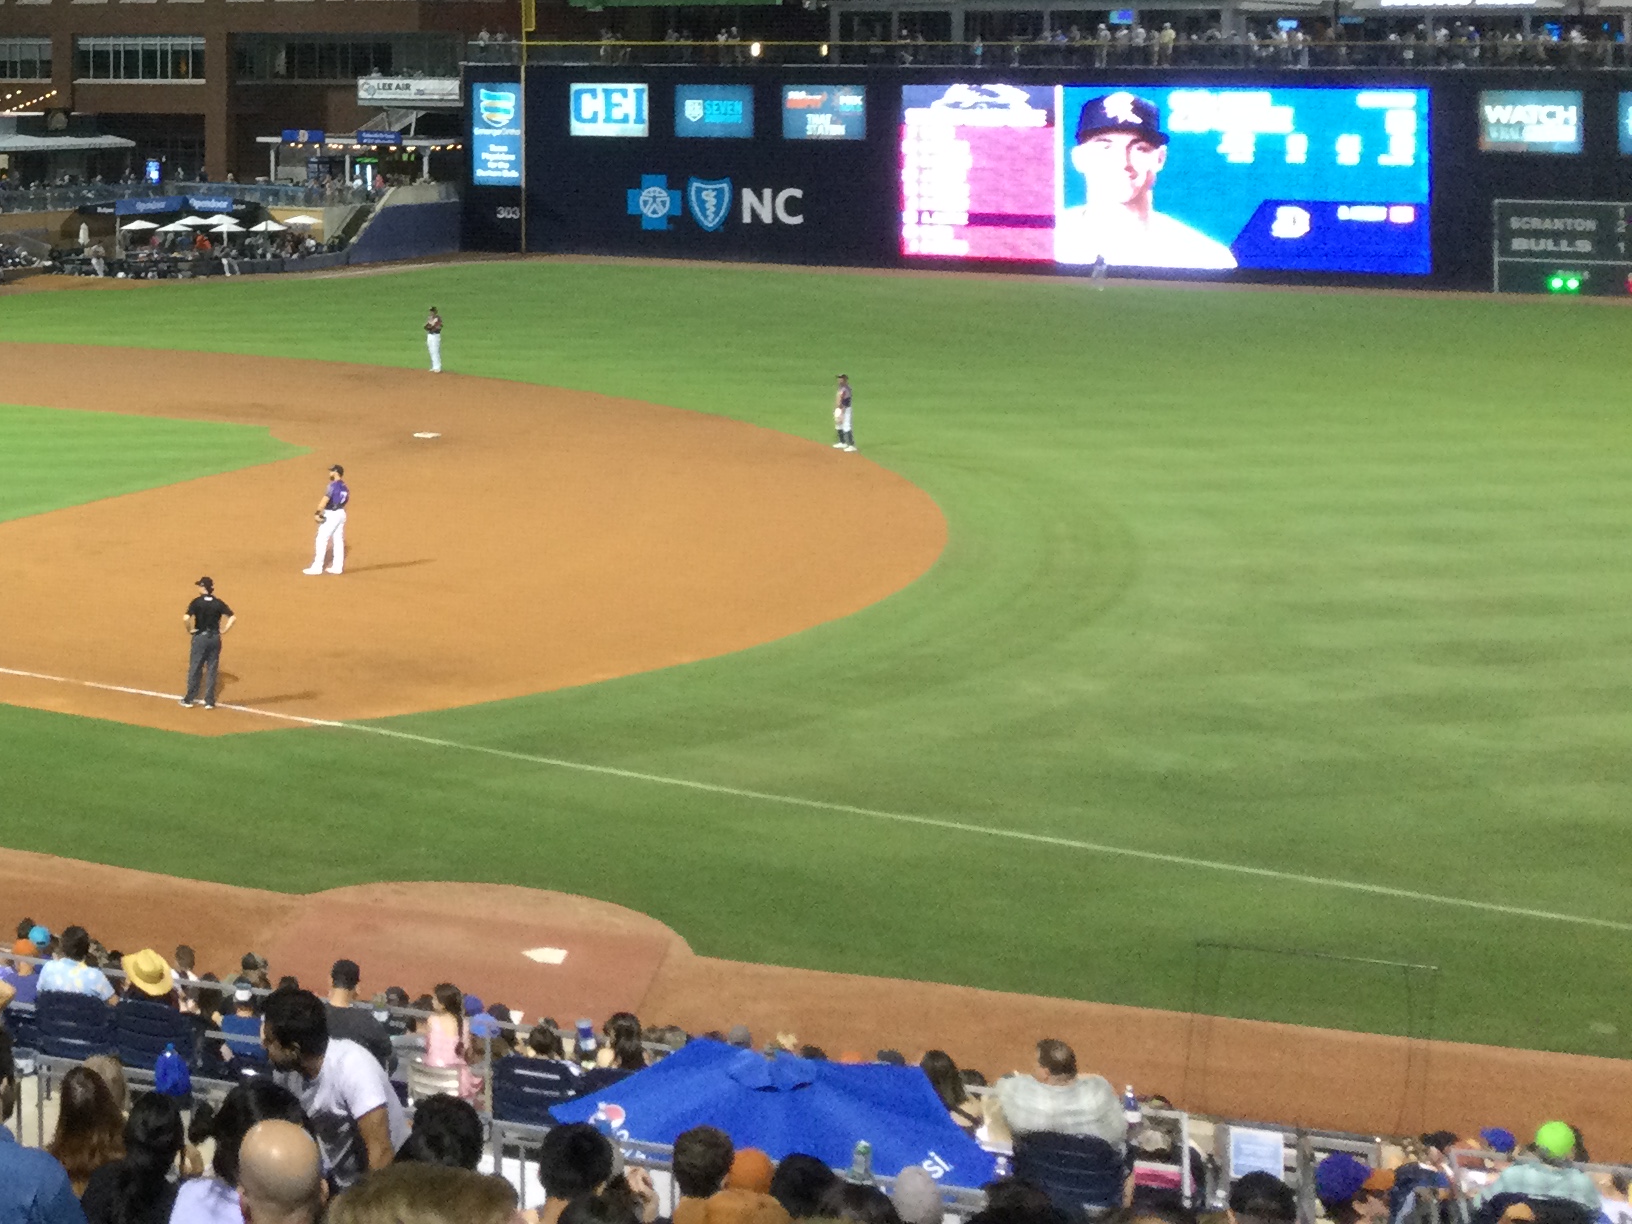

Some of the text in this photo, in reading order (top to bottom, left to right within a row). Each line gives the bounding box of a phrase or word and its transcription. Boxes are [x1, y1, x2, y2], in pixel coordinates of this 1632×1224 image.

[573, 88, 646, 124] CEI
[1484, 105, 1577, 125] WATCH
[496, 207, 520, 219] 303
[741, 187, 805, 225] NC
[1511, 238, 1592, 252] BULLS
